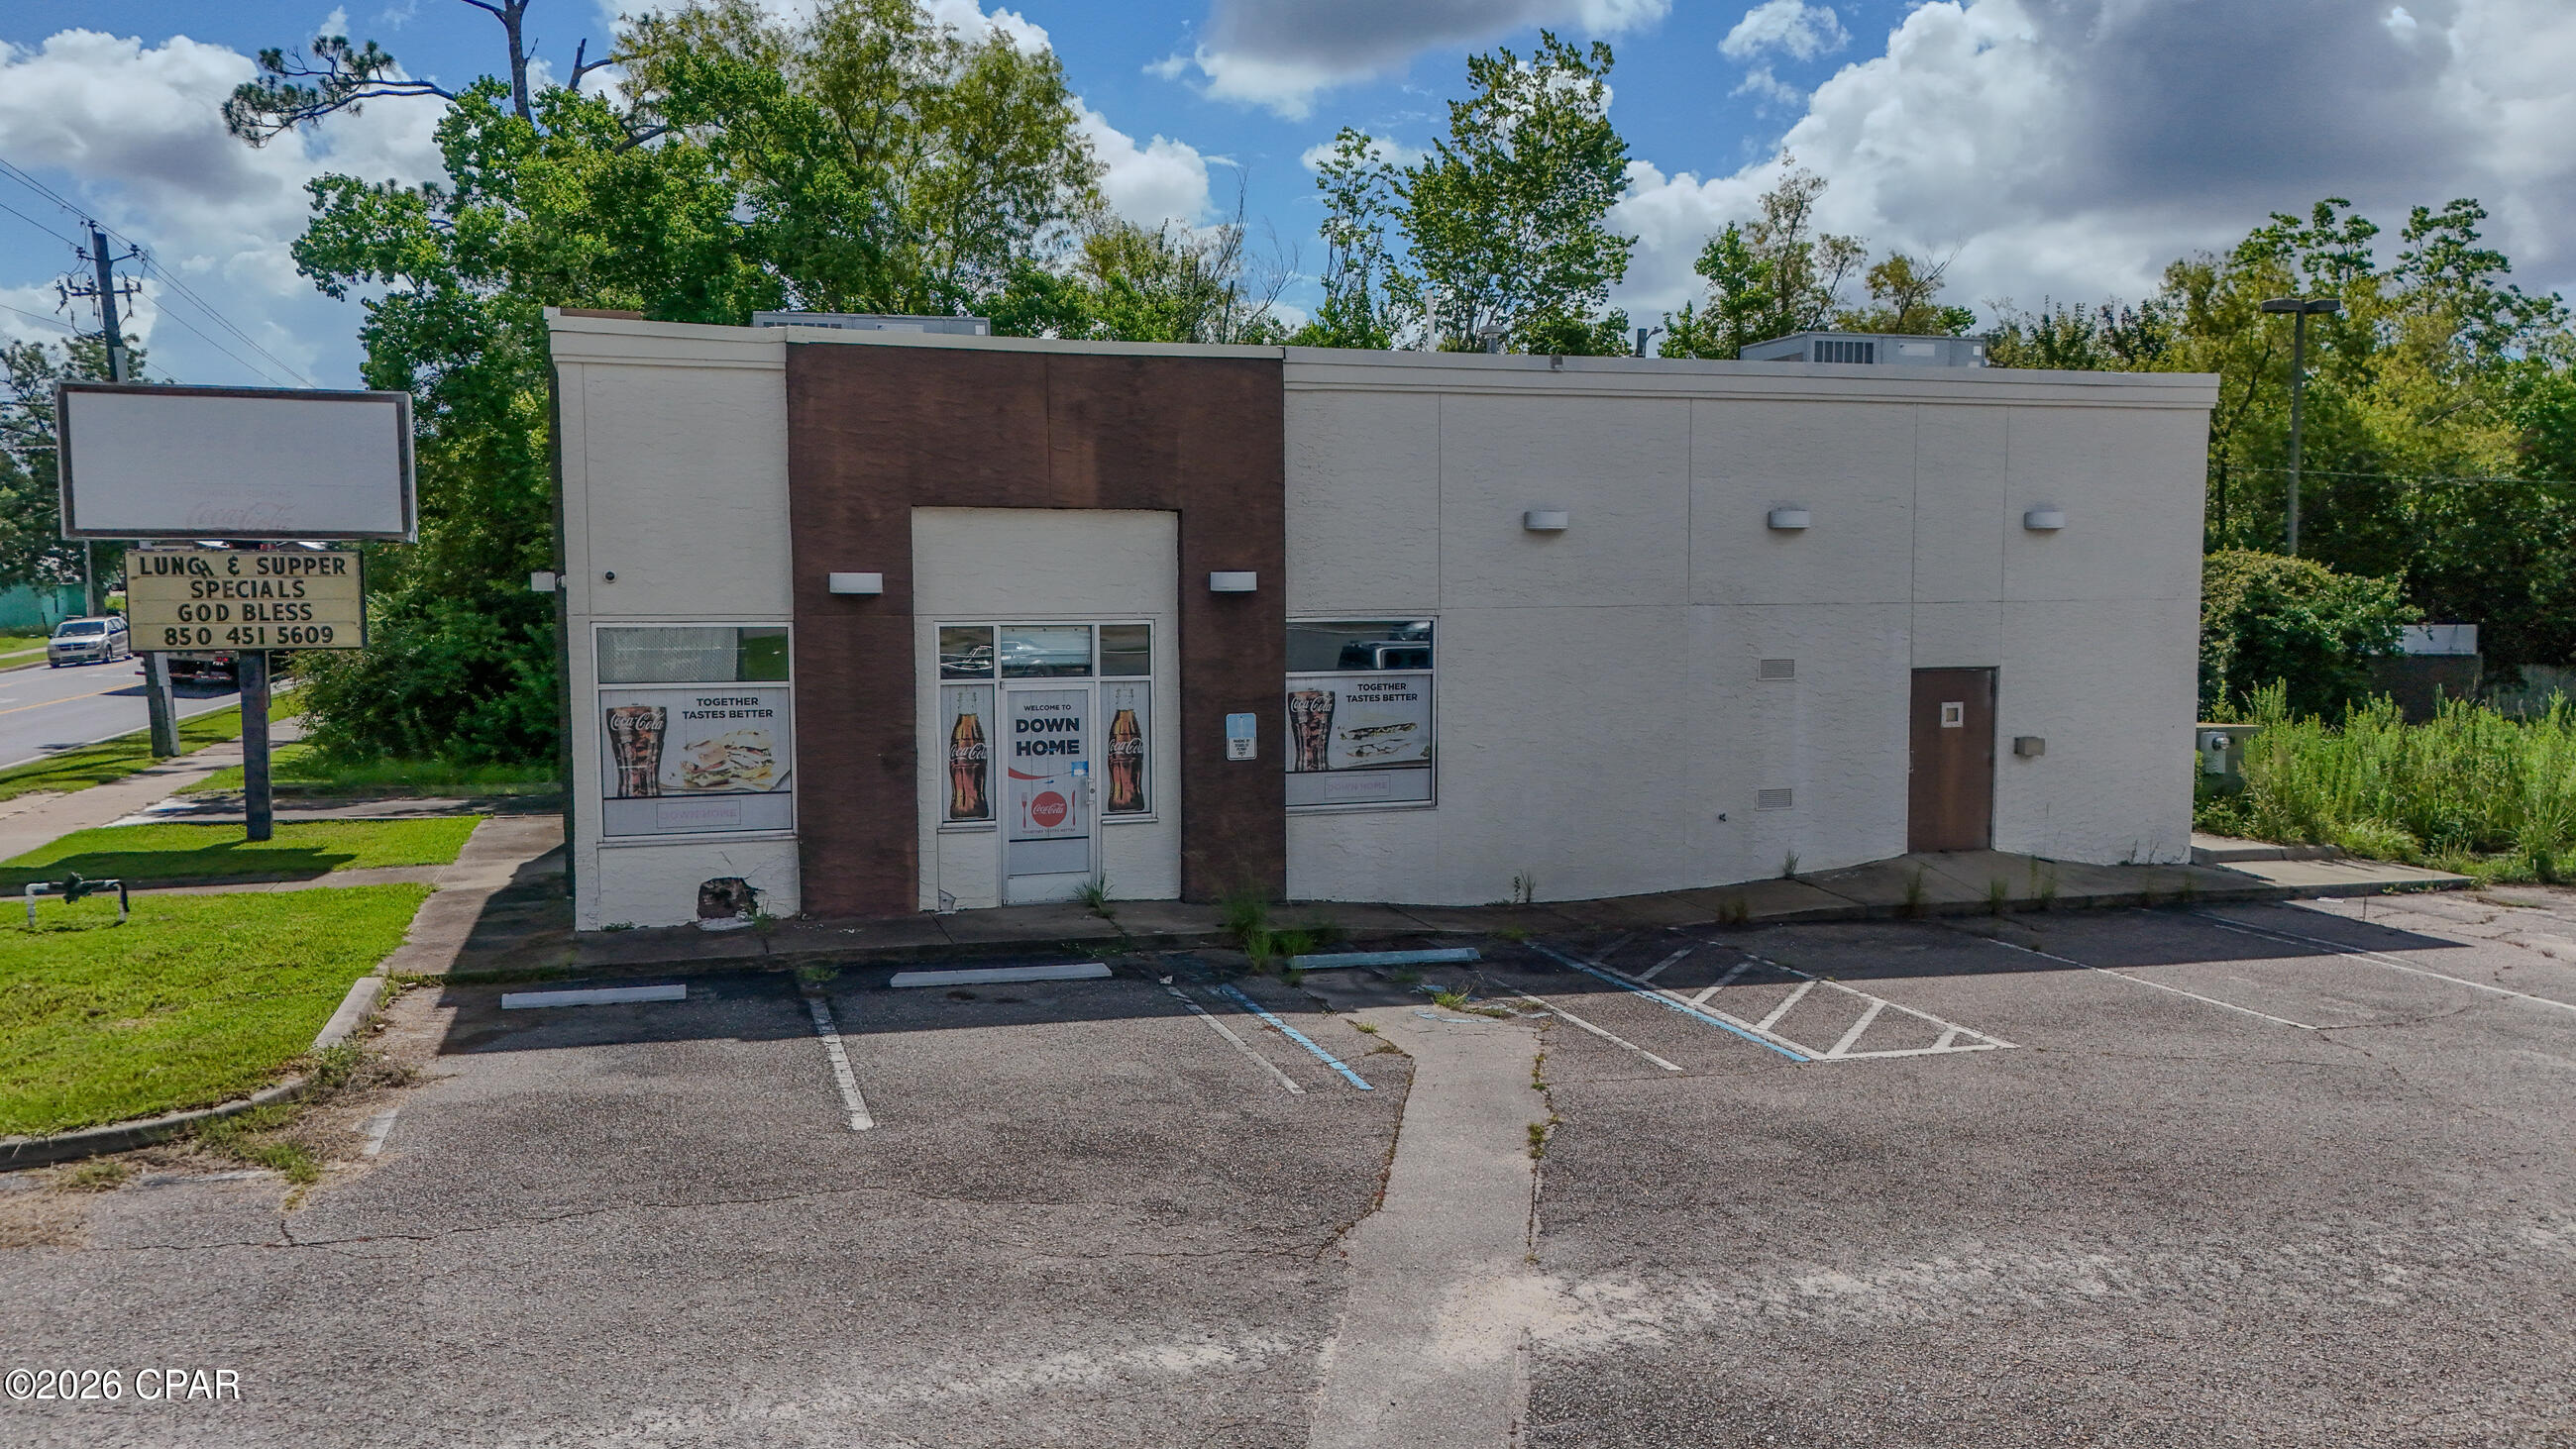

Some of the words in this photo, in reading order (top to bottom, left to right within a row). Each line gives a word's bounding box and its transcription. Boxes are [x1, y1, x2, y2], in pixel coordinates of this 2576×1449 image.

[140, 556, 214, 578] LUNCH
[227, 556, 241, 576] &
[257, 556, 346, 575] SUPPER
[190, 579, 305, 599] SPECIALS
[177, 603, 229, 622] GOD
[242, 602, 312, 622] BLESS
[164, 627, 212, 646] 850
[226, 626, 265, 645] 451
[277, 625, 334, 644] 5609
[1357, 682, 1407, 691] TOGETHER
[697, 697, 759, 707] TOGETHER
[1290, 694, 1333, 713] Coca-Cola
[1345, 694, 1380, 703] TASTES
[1383, 692, 1418, 702] BETTER
[609, 711, 666, 731] Coca-Cola
[683, 710, 726, 720] TASTES
[729, 709, 773, 719] BETTER
[1016, 717, 1080, 733] DOWN
[1016, 739, 1080, 757] HOME
